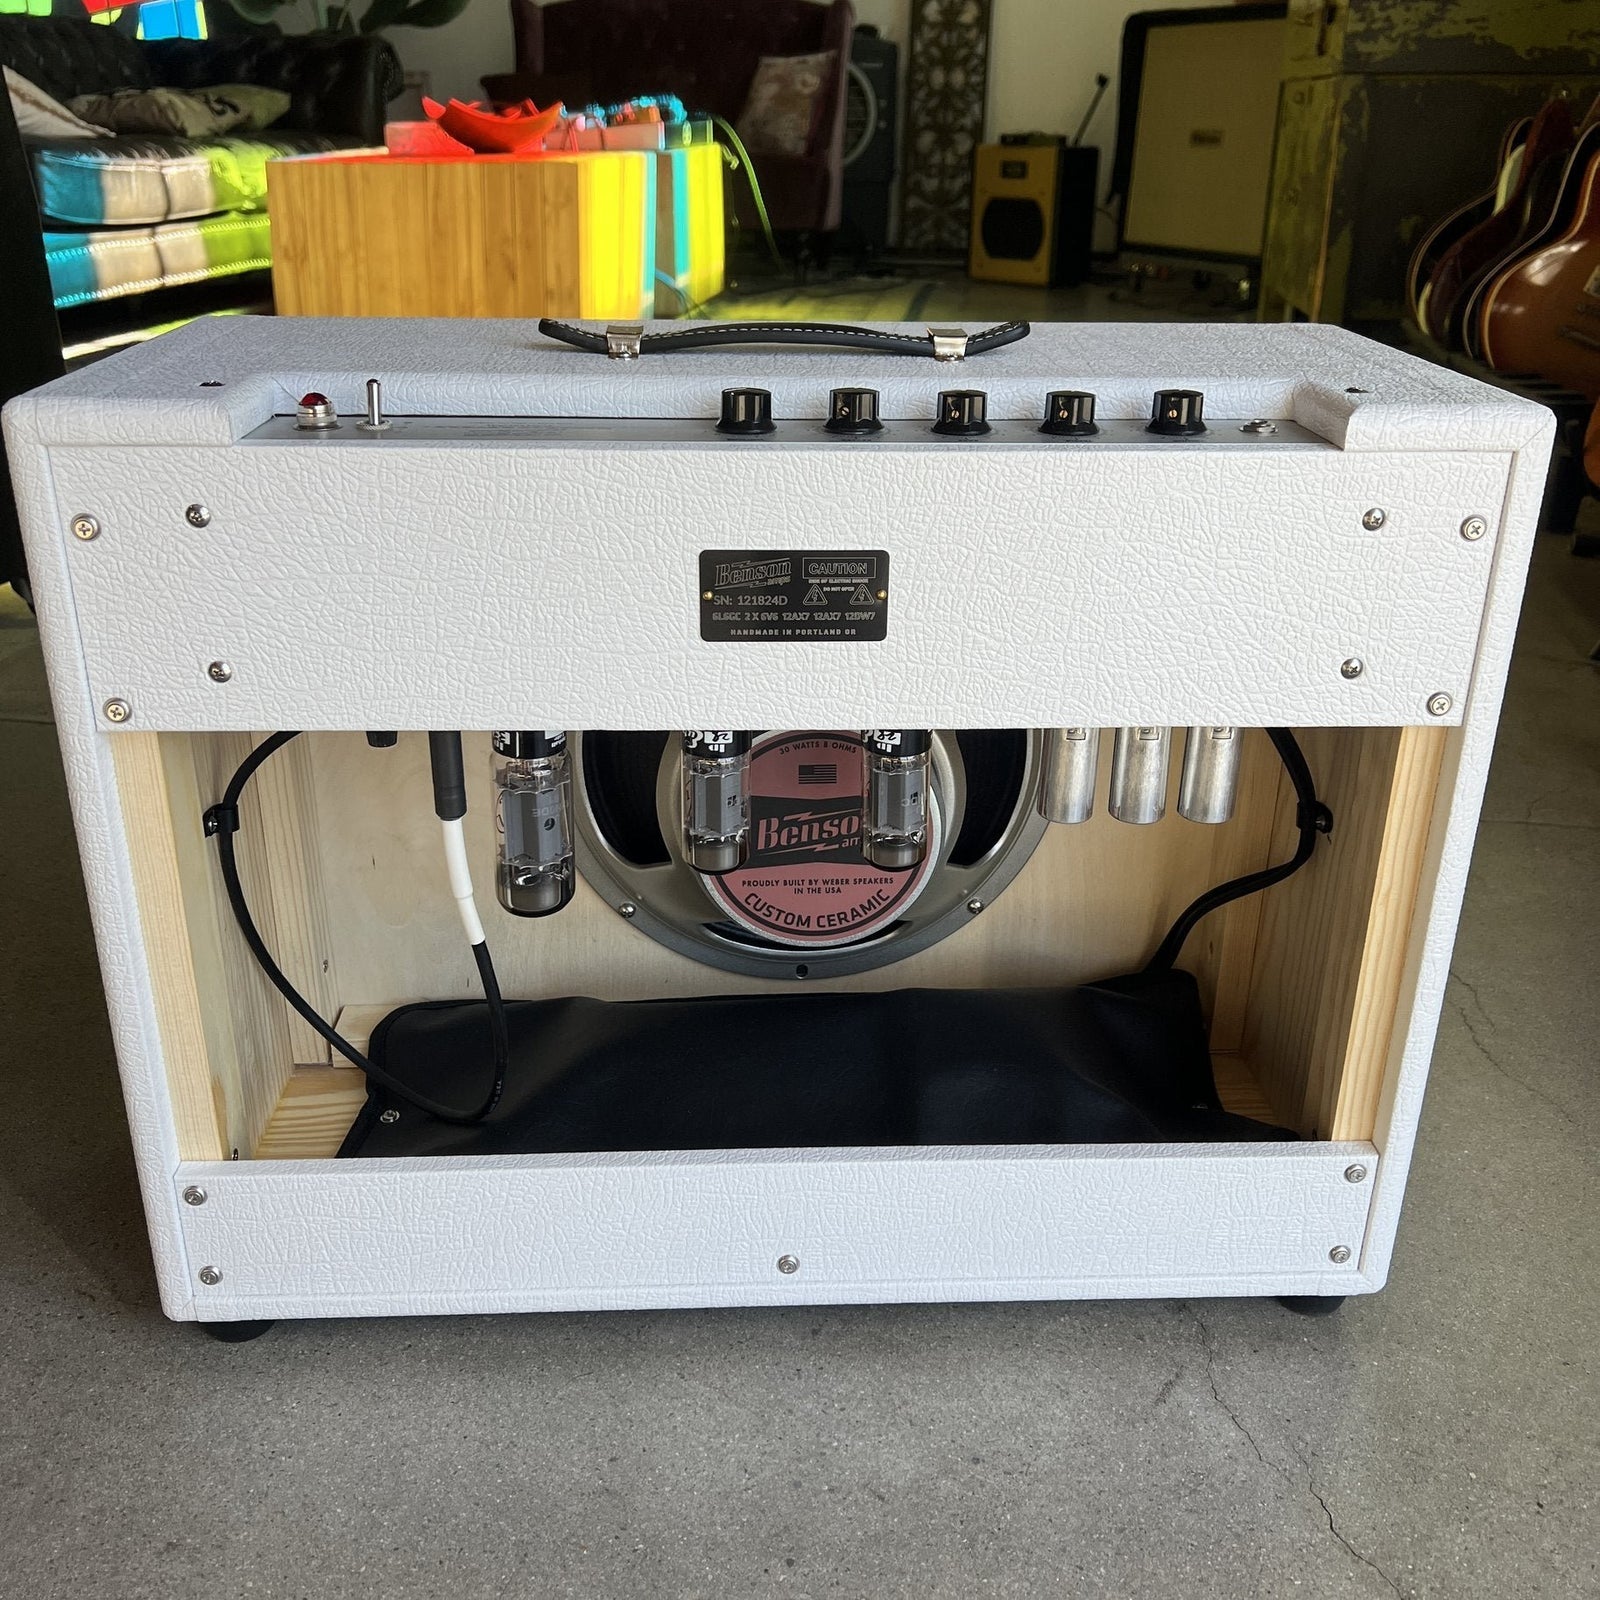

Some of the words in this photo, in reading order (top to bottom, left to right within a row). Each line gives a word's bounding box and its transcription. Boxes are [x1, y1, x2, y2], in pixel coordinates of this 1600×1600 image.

[714, 561, 792, 586] Benson
[808, 562, 868, 575] CAUTION
[713, 595, 733, 606] SN:
[737, 595, 788, 606] 121824D
[712, 612, 741, 621] 6L6GC
[744, 612, 751, 621] 2
[752, 612, 760, 621] X
[760, 612, 779, 621] 6V6
[782, 612, 810, 621] 12AX7
[813, 612, 841, 621] 12AX7
[844, 612, 876, 621] 12DW7
[780, 746, 790, 755] 30
[792, 741, 820, 751] WATTS
[831, 742, 857, 754] OHMS
[757, 815, 860, 850] Benso
[742, 879, 780, 887] PROUDLY
[783, 879, 805, 887] BUILT
[822, 878, 850, 886] WEBER
[853, 877, 894, 885] SPEAKERS
[794, 887, 804, 895] IN
[825, 886, 842, 894] USA
[744, 892, 811, 929] CUSTOM
[816, 888, 890, 928] CERAMIC
